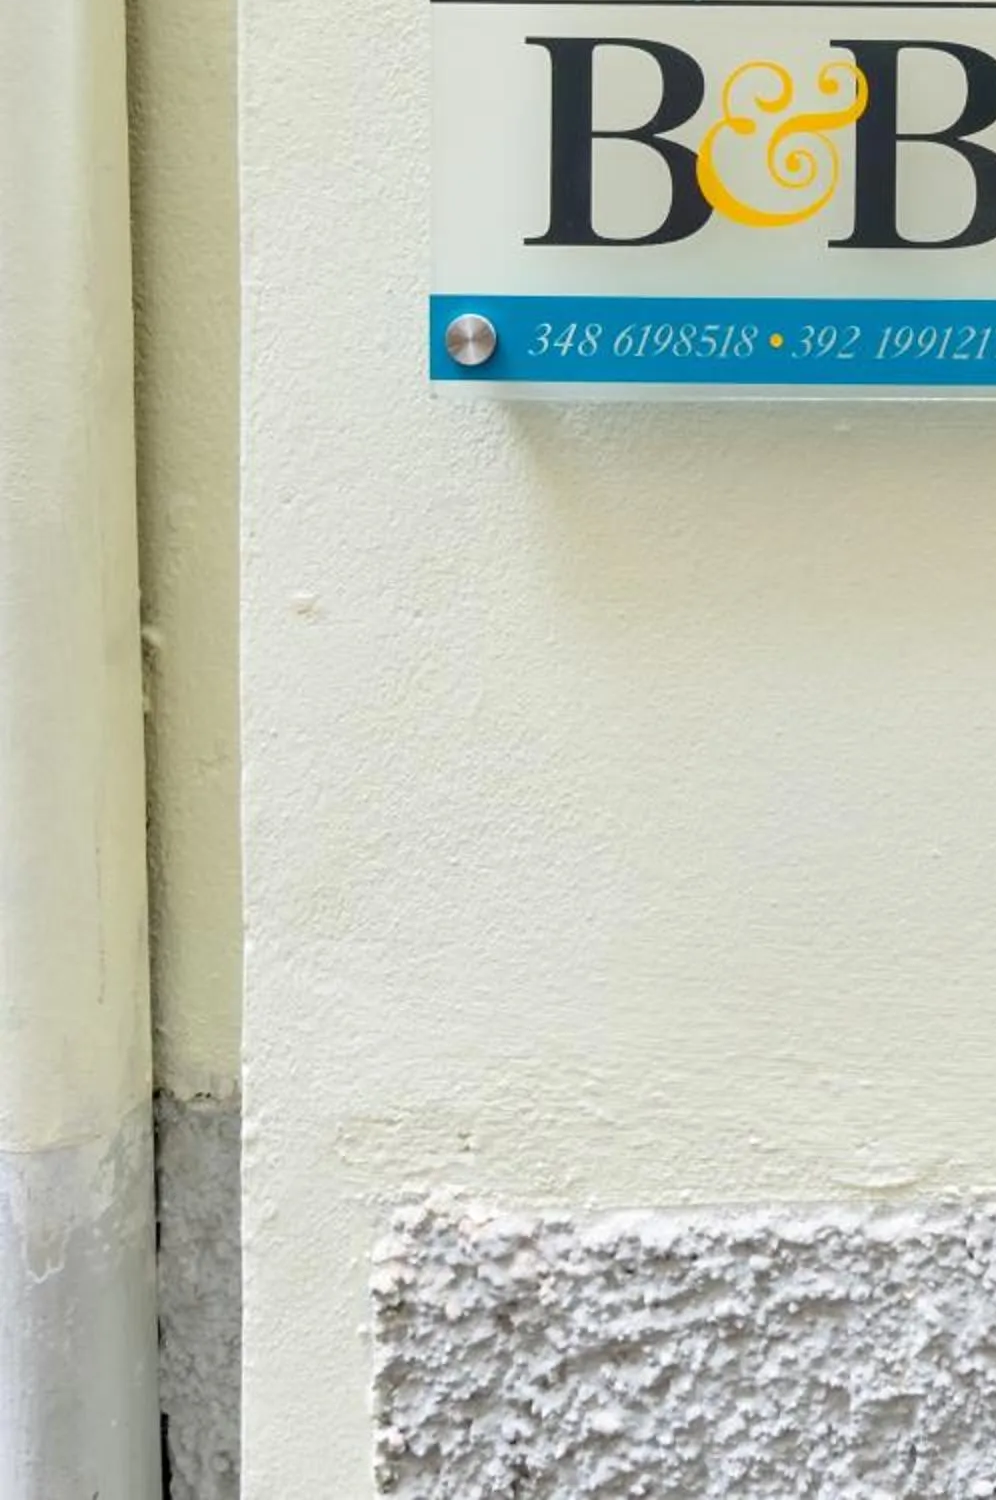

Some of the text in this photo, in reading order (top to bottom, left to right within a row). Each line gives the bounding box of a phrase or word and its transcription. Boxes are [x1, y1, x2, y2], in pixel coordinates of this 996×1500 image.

[527, 322, 602, 357] 348
[612, 323, 759, 358] 6198518
[791, 325, 863, 360] 392
